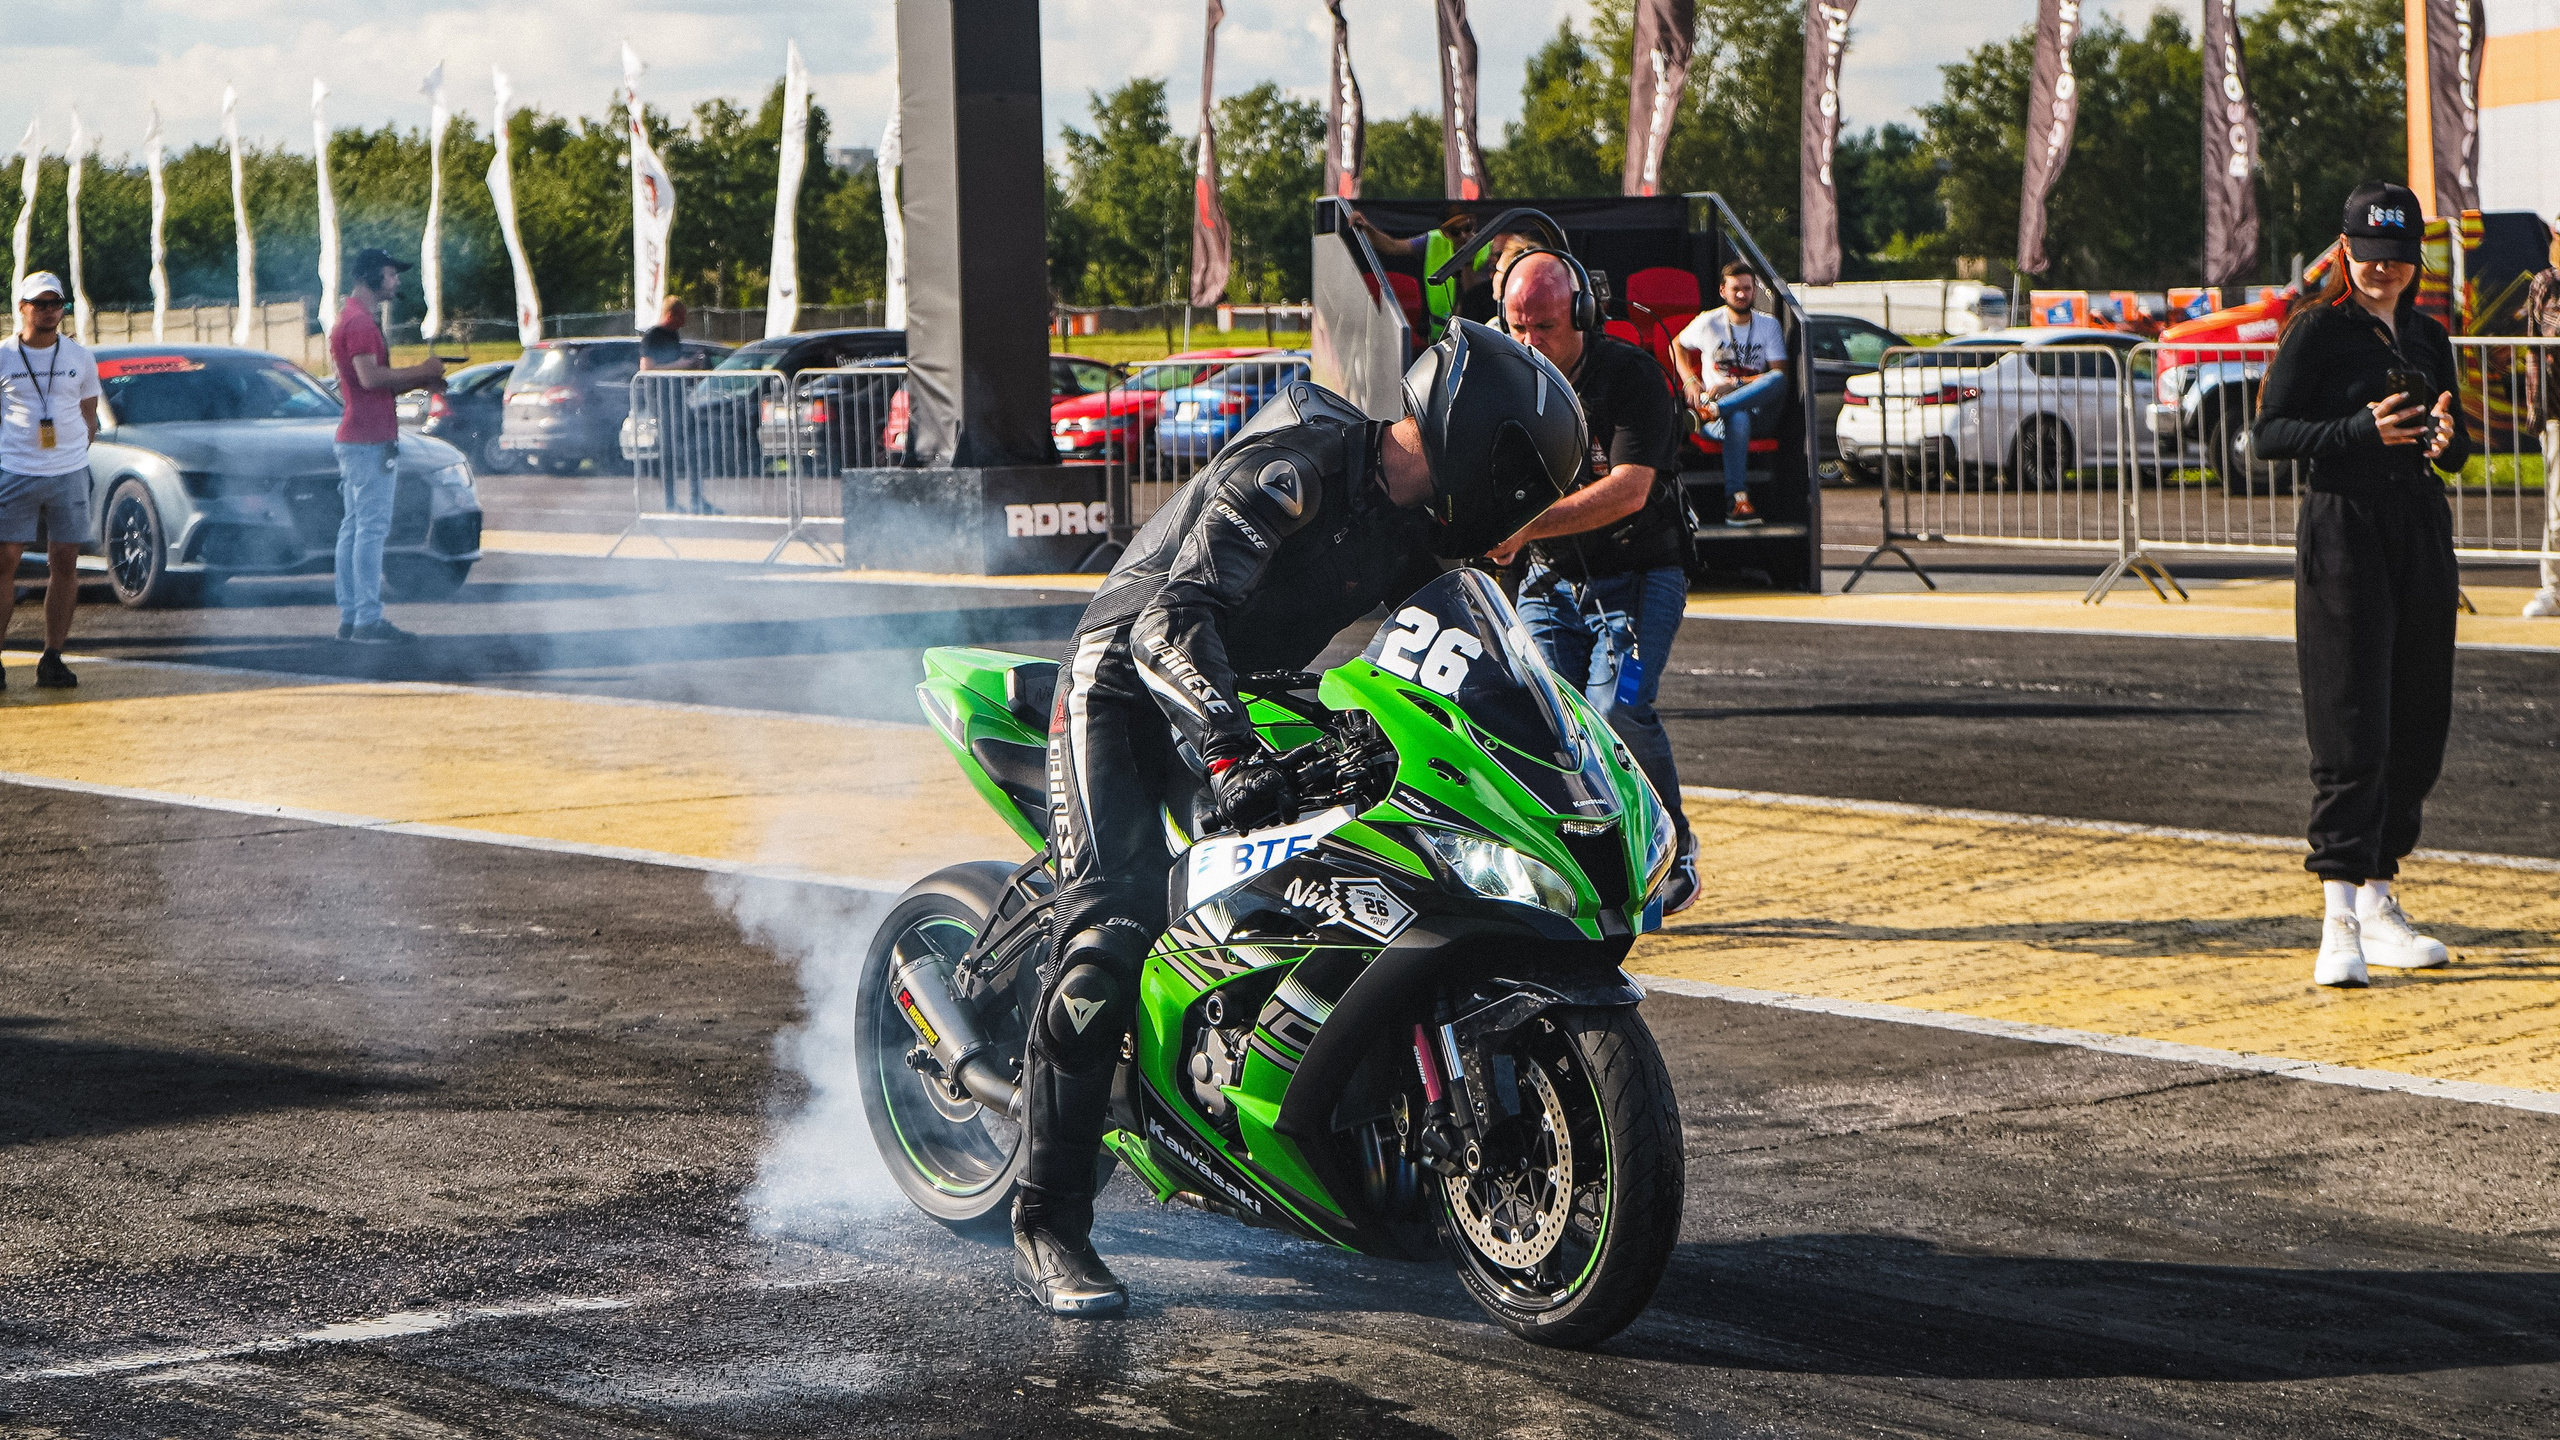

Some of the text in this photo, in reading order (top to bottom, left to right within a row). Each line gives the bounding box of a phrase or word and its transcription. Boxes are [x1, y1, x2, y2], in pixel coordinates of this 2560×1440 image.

[1004, 501, 1107, 537] RDRC
[1376, 605, 1482, 696] 26
[1363, 897, 1390, 917] 26
[1149, 1117, 1263, 1215] Kawasaki
